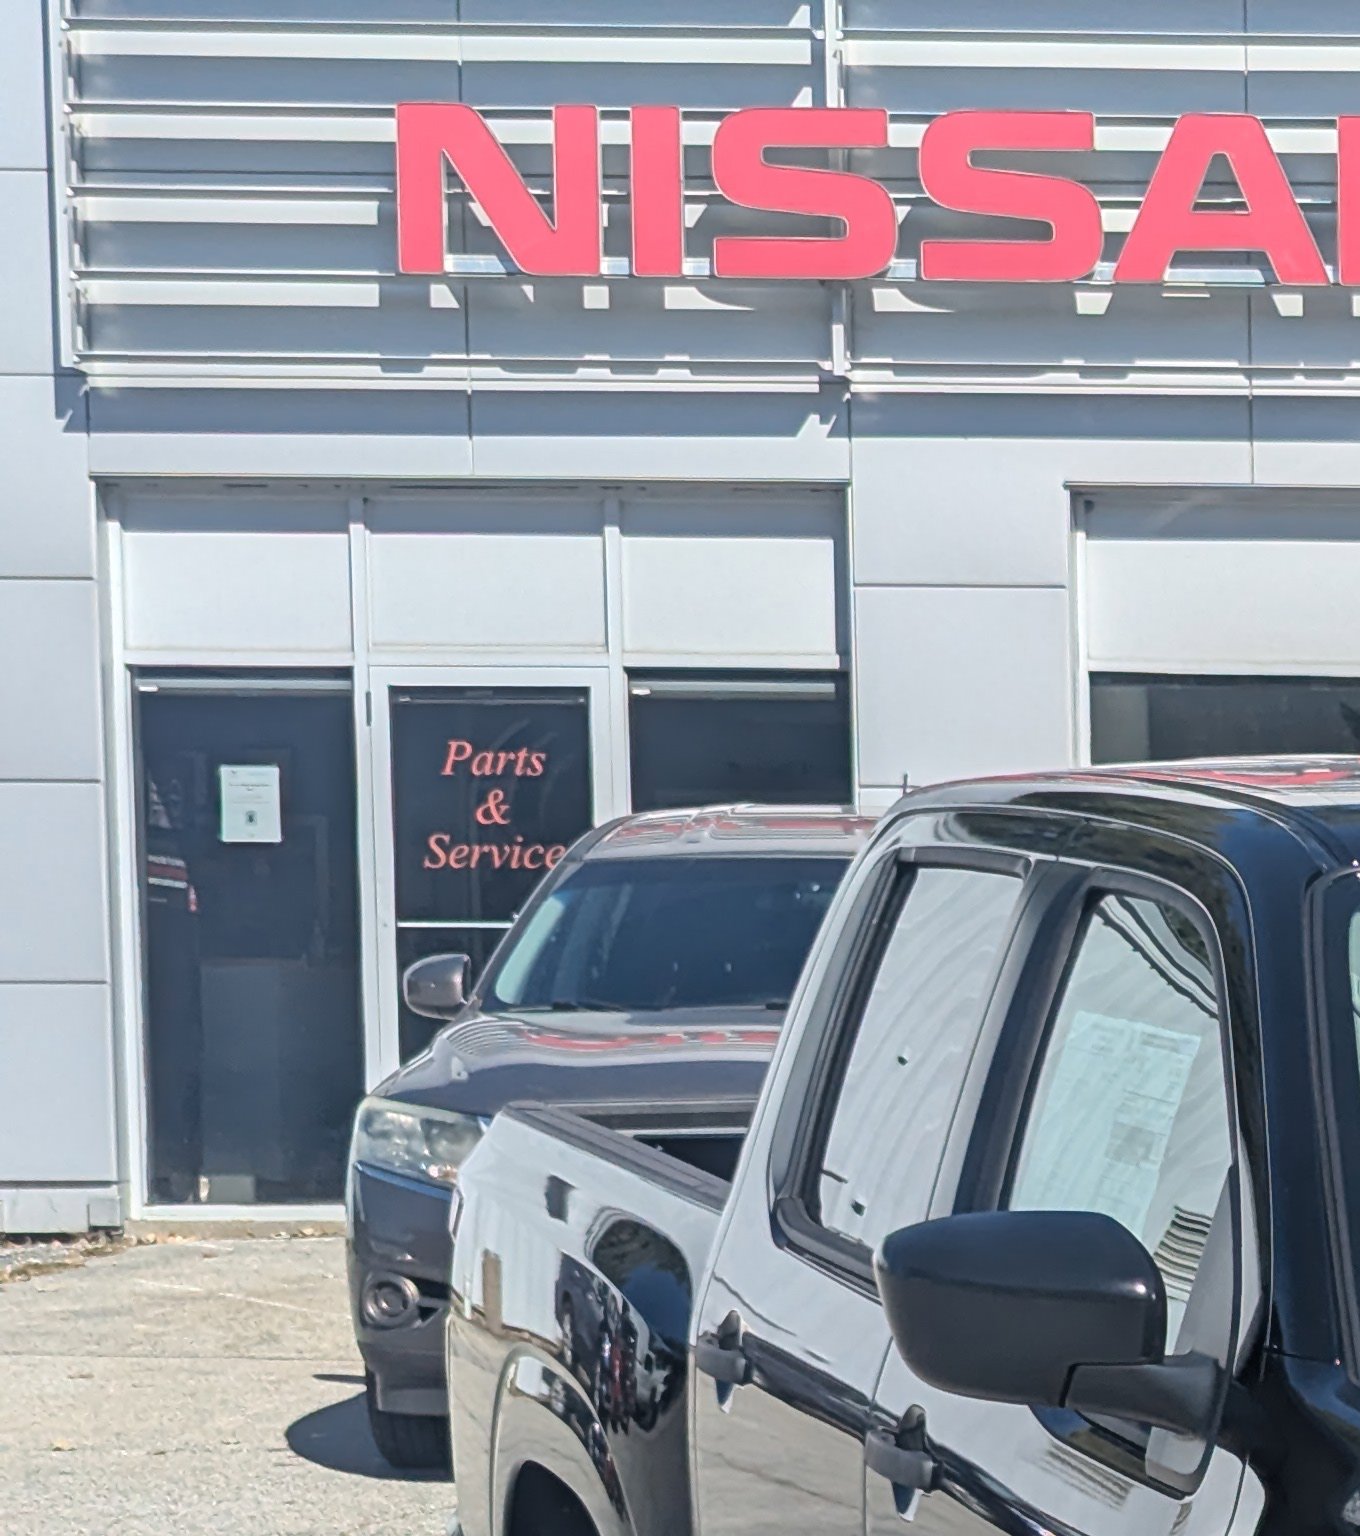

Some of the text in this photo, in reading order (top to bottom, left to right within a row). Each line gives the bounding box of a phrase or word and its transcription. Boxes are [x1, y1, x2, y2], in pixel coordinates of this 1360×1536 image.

[441, 739, 547, 777] Parts
[475, 788, 511, 825] &
[423, 833, 566, 870] Service
